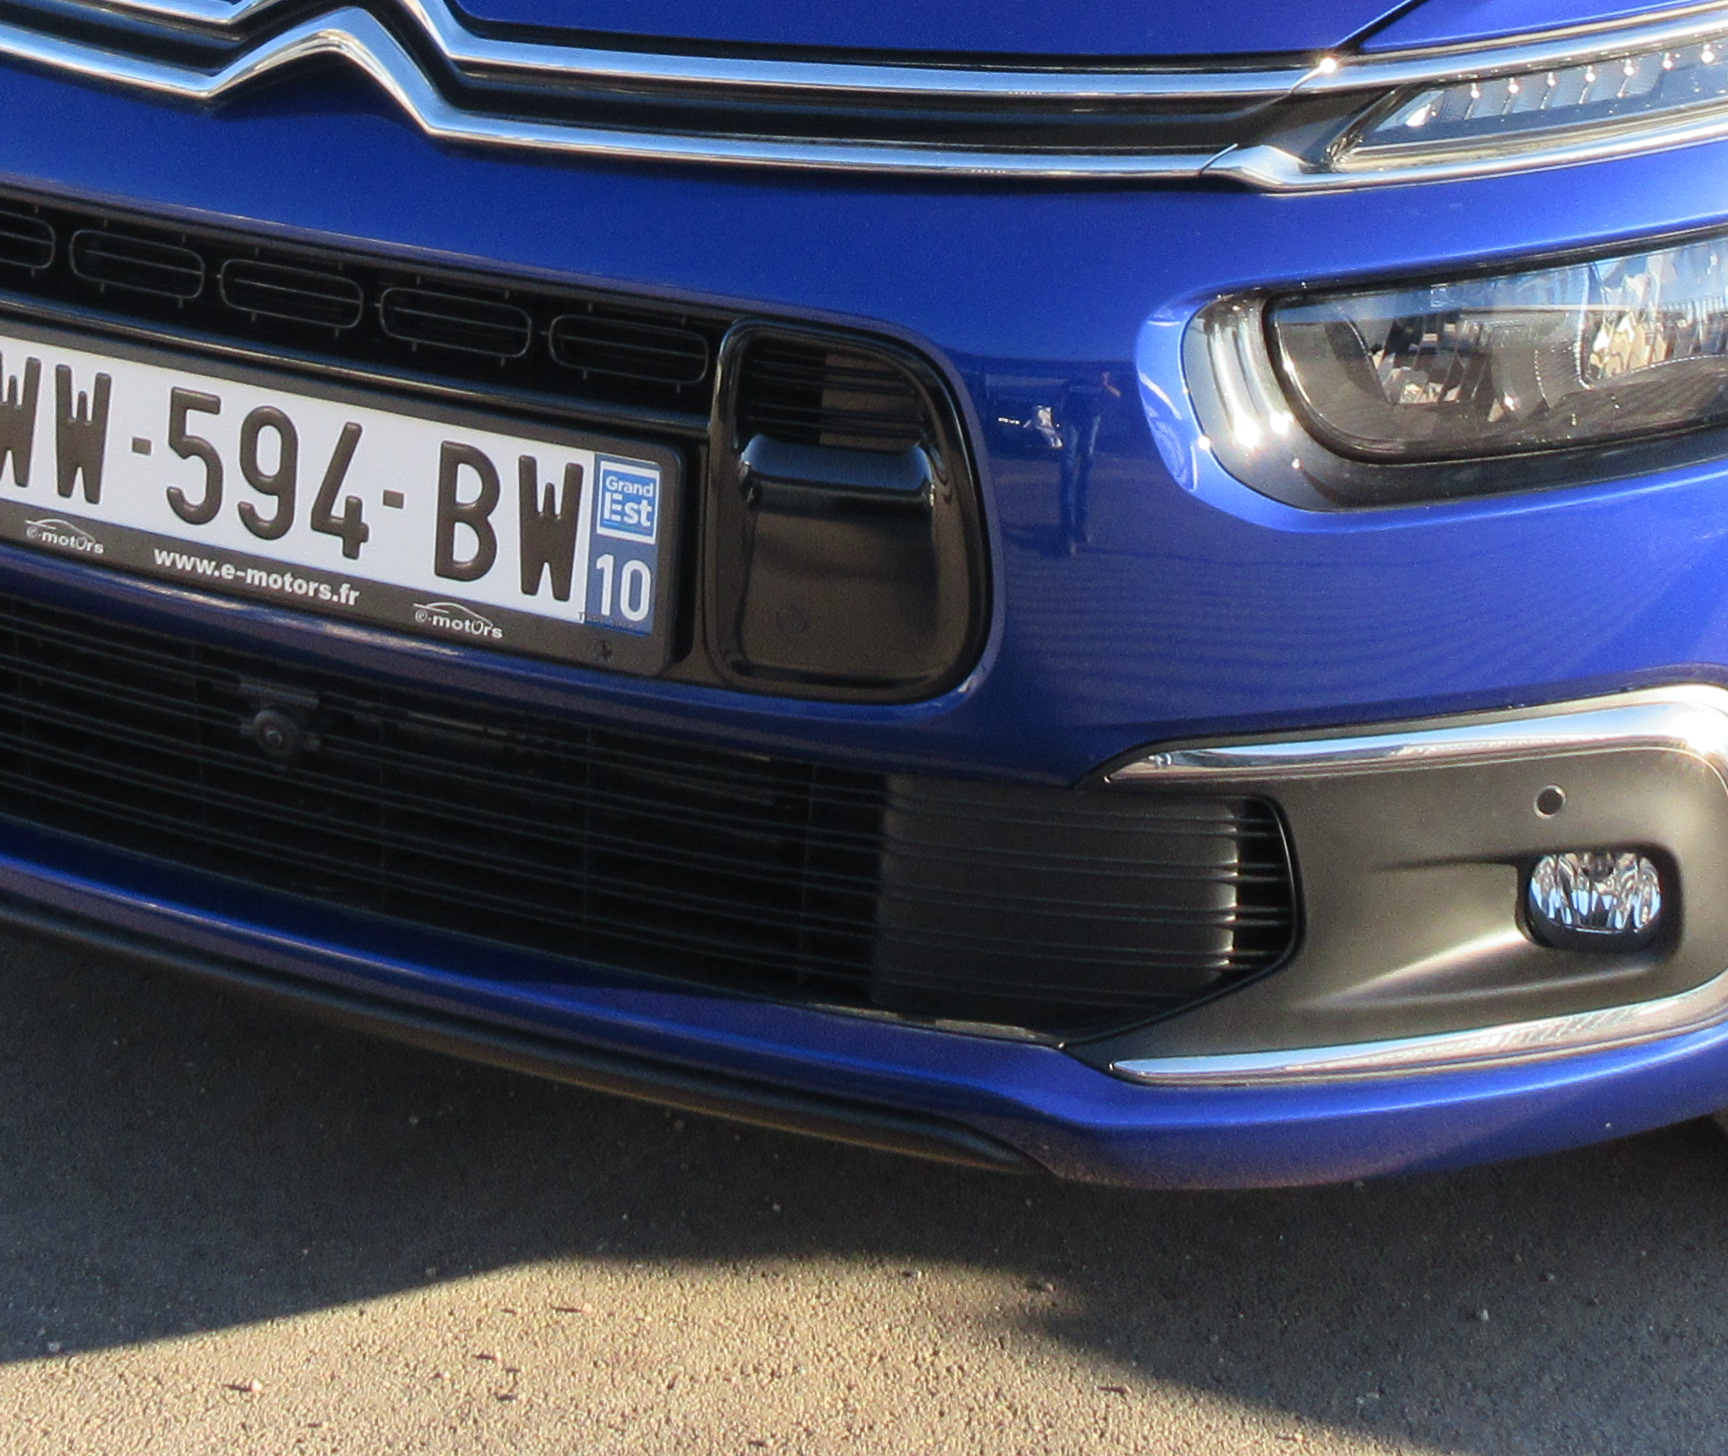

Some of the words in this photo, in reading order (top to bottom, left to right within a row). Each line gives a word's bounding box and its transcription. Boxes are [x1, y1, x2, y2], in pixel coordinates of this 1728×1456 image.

[603, 491, 653, 527] Est
[605, 475, 654, 498] Grand
[153, 548, 360, 606] www.e-motors.fr
[596, 553, 652, 622] 10
